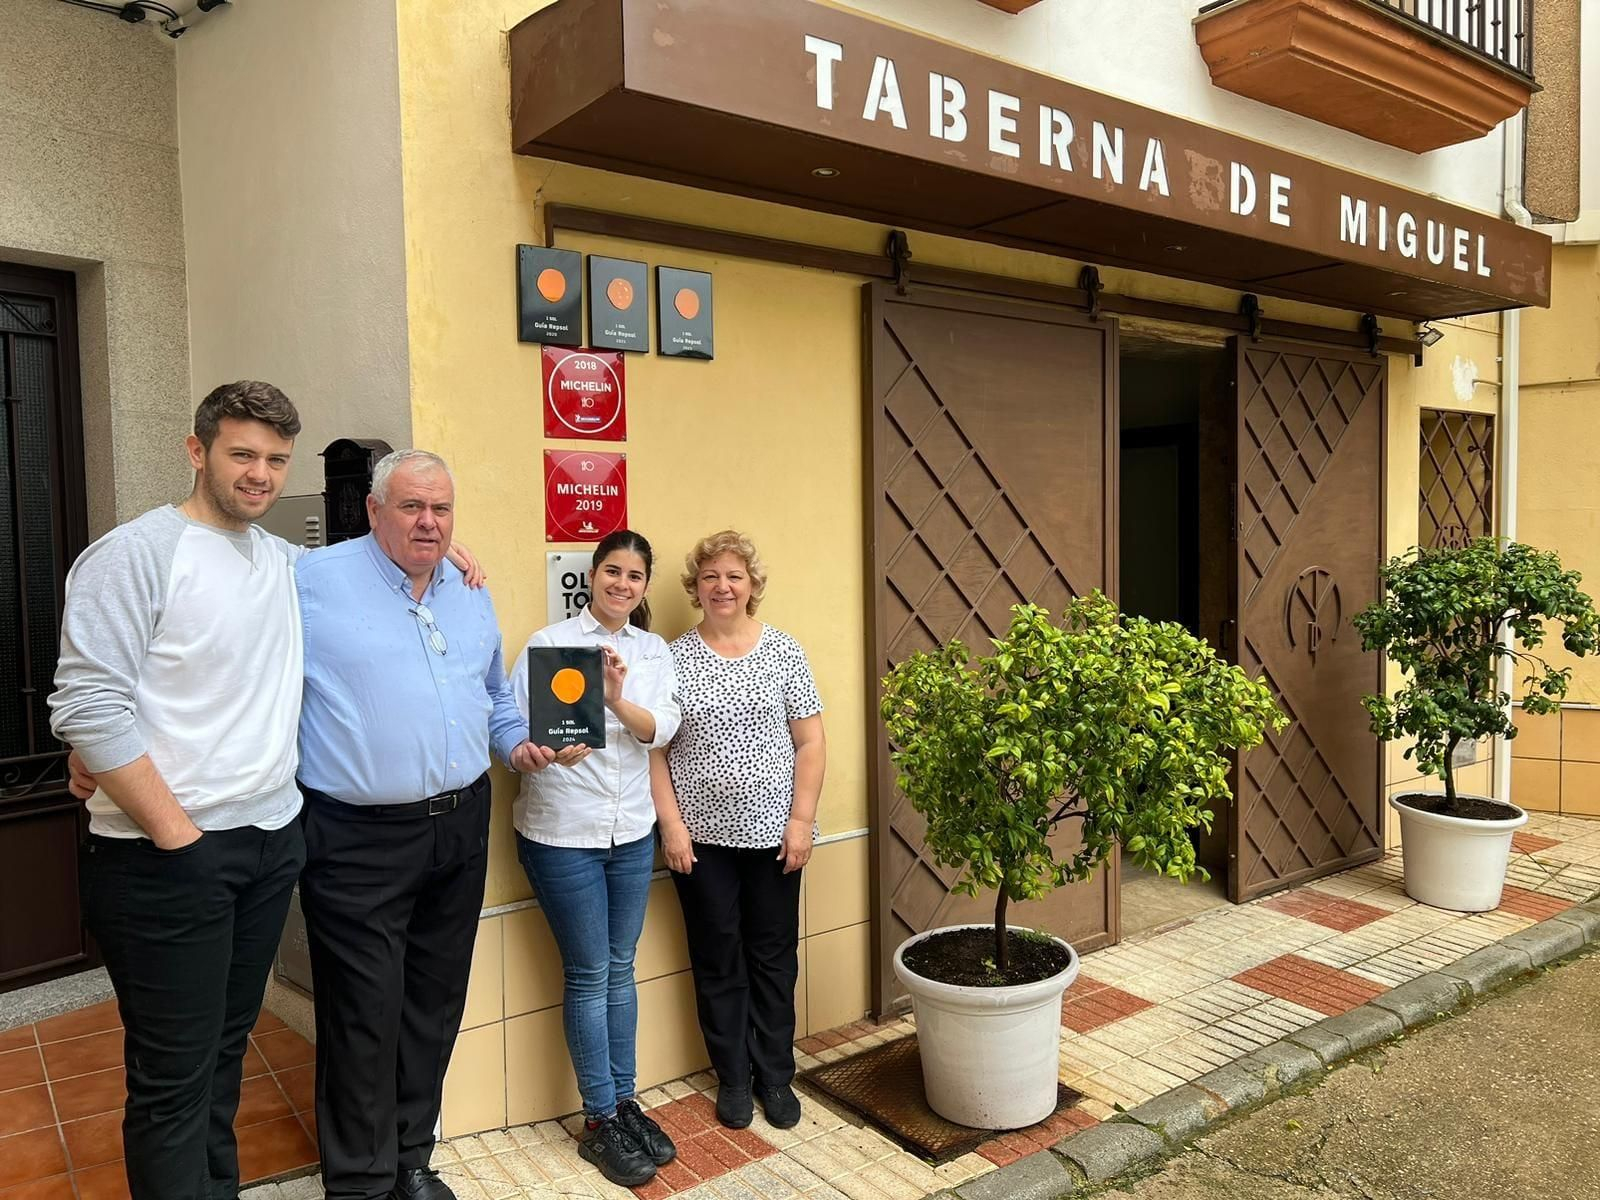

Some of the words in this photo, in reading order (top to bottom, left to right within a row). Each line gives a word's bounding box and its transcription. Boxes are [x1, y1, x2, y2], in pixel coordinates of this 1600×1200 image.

[804, 34, 1171, 197] TABERNA
[1229, 161, 1292, 228] DE
[1339, 193, 1492, 278] MIGUEL
[548, 323, 569, 331] Repsol
[617, 330, 637, 338] Repsol
[574, 361, 597, 371] 2018
[560, 380, 612, 393] MICHELIN
[557, 483, 619, 496] MICHELIN
[575, 499, 603, 511] 2019
[561, 572, 588, 589] OL
[562, 591, 593, 609] TO
[565, 727, 589, 735] Repsol
